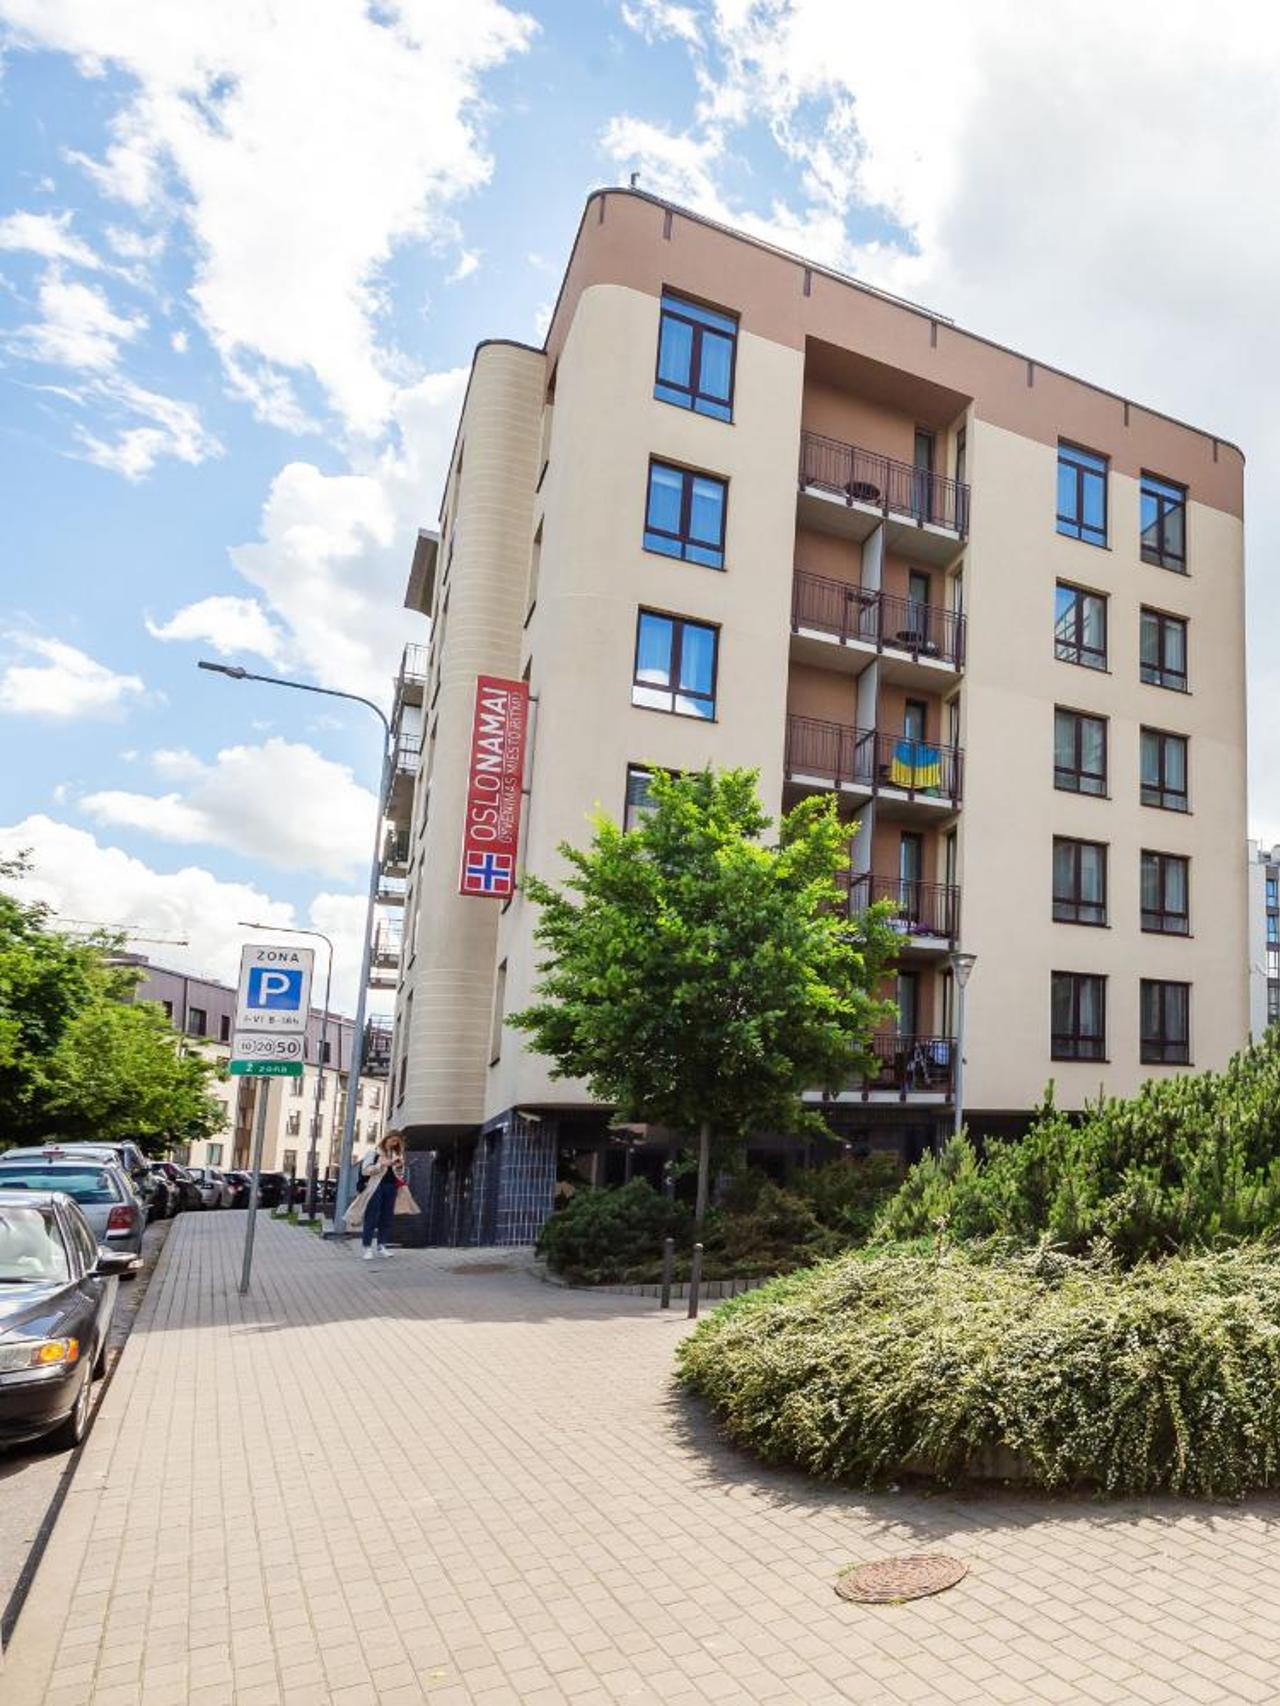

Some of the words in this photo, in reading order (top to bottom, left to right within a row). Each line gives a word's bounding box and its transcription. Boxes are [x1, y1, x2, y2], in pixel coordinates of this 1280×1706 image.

[256, 950, 300, 963] ZONA
[259, 972, 291, 1006] P
[257, 1042, 272, 1051] 20
[277, 1042, 297, 1053] 50
